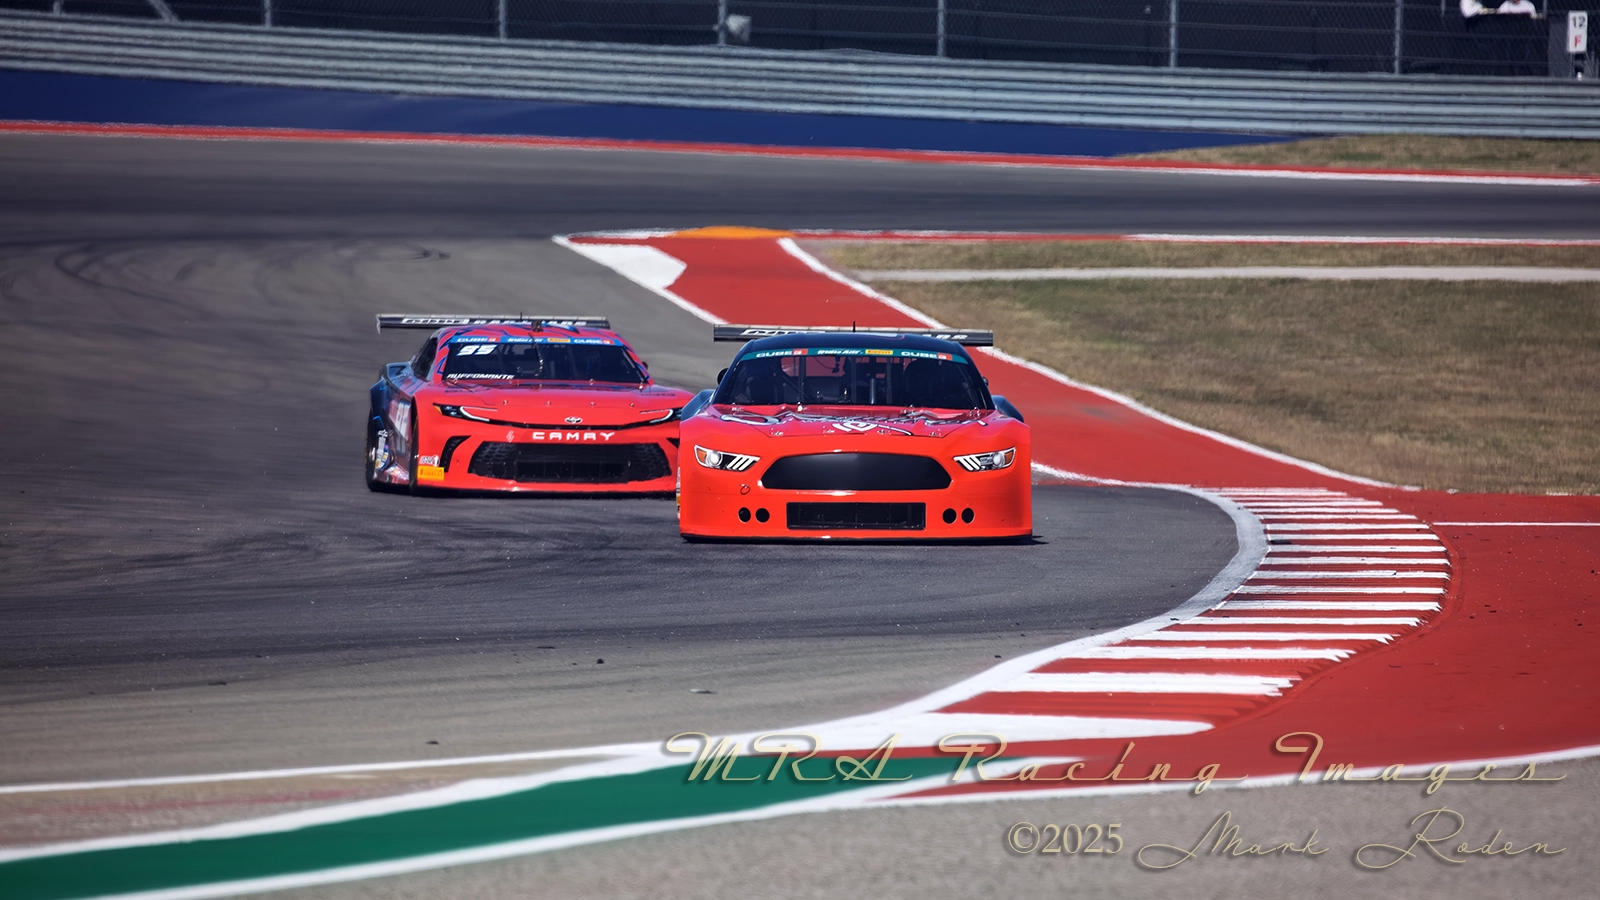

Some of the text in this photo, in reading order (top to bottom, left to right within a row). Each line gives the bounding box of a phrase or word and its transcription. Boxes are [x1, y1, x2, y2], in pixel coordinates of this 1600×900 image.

[1572, 15, 1586, 29] 12
[1574, 34, 1582, 47] F
[456, 344, 497, 356] 95
